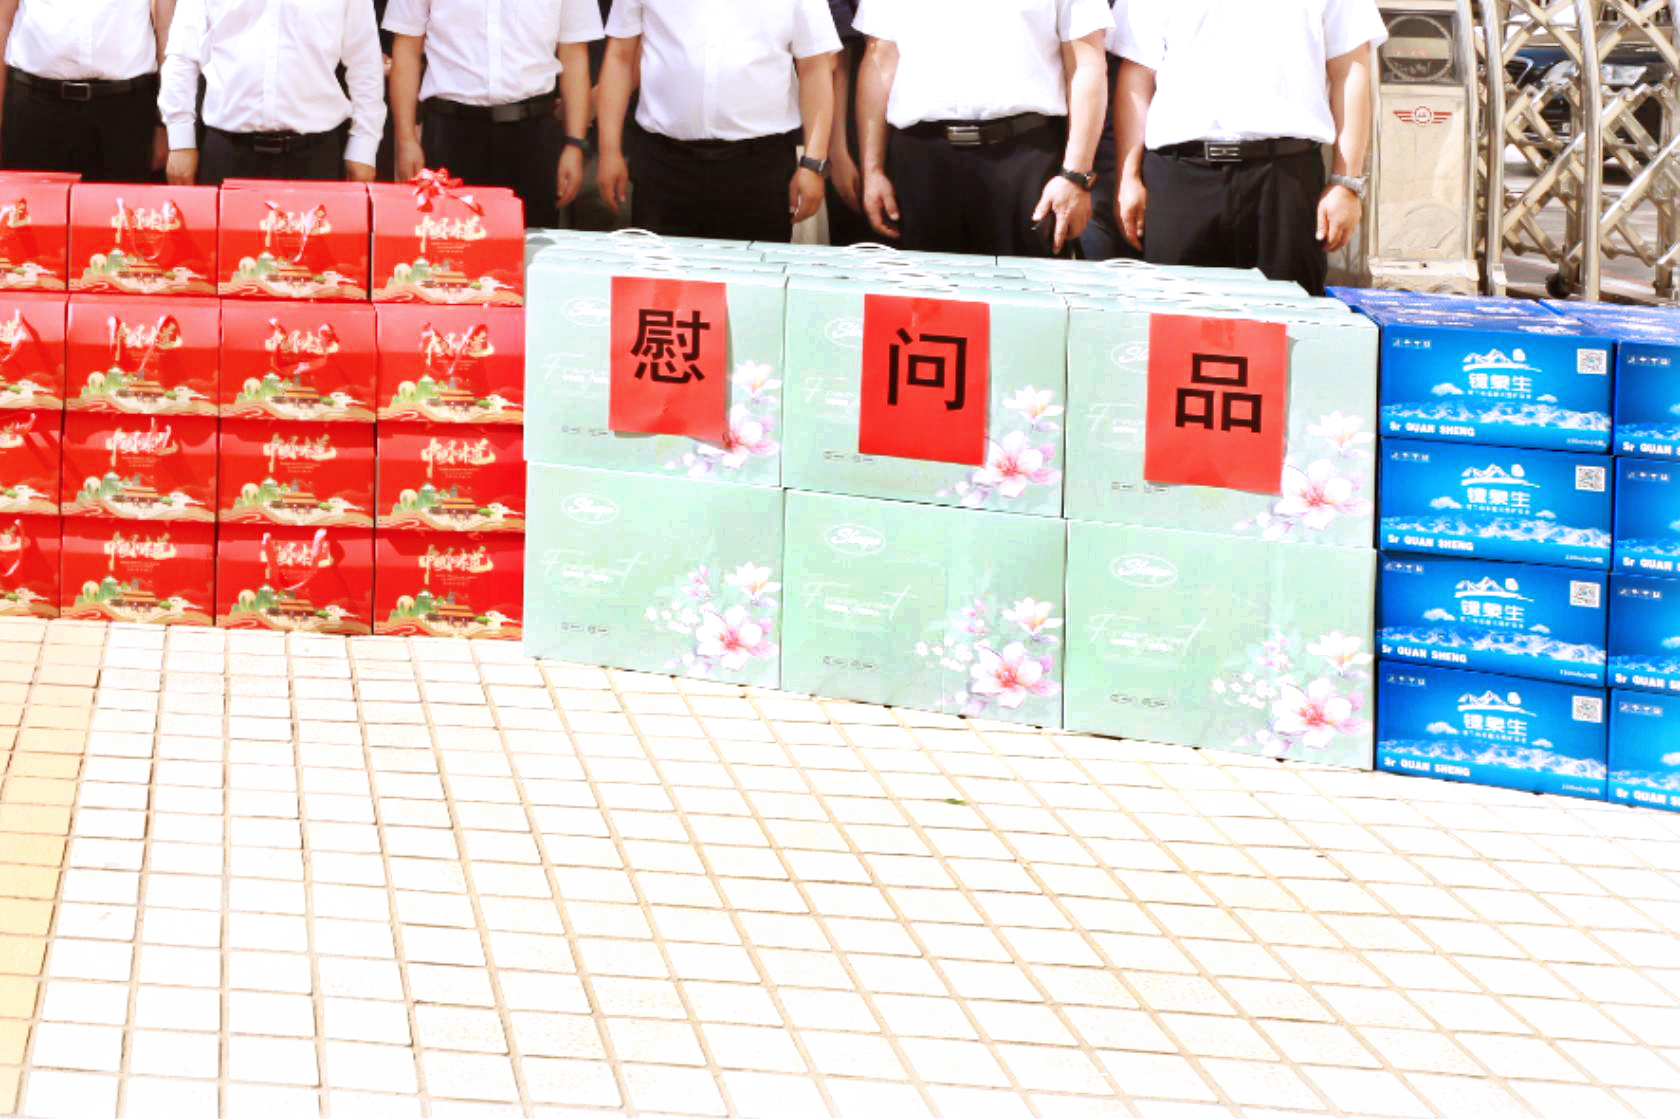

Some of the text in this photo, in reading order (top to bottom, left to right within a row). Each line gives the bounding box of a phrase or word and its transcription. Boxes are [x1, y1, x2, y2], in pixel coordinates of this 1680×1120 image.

[630, 308, 1263, 433] 慰 问 品
